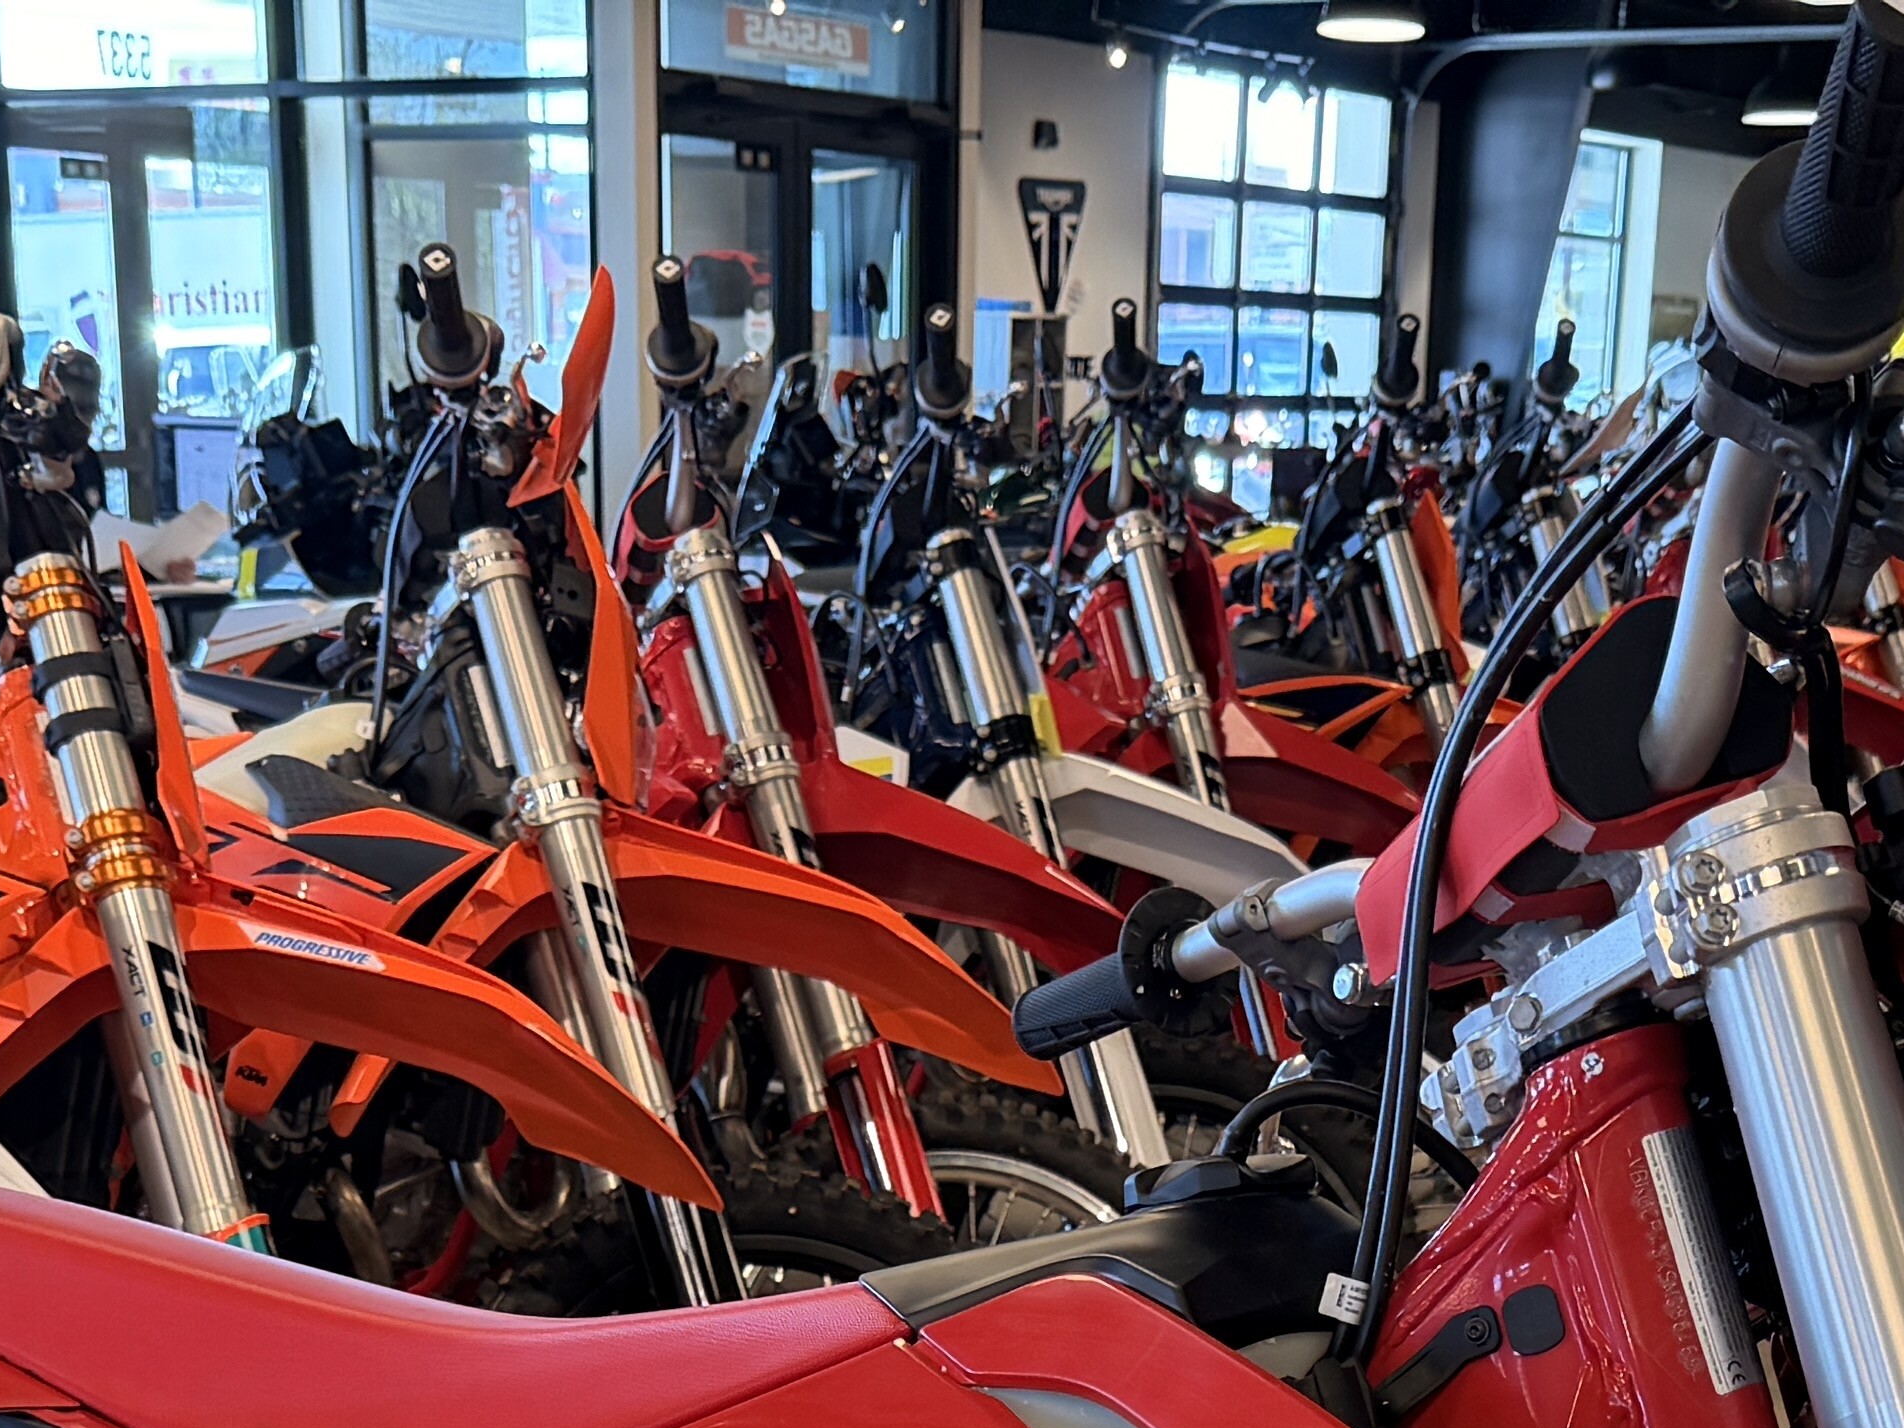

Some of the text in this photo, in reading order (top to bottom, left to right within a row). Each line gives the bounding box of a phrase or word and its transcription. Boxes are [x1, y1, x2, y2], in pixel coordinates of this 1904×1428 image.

[254, 931, 370, 965] PROGRESSIVE
[122, 946, 145, 996] XACT
[234, 1065, 269, 1087] KTM
